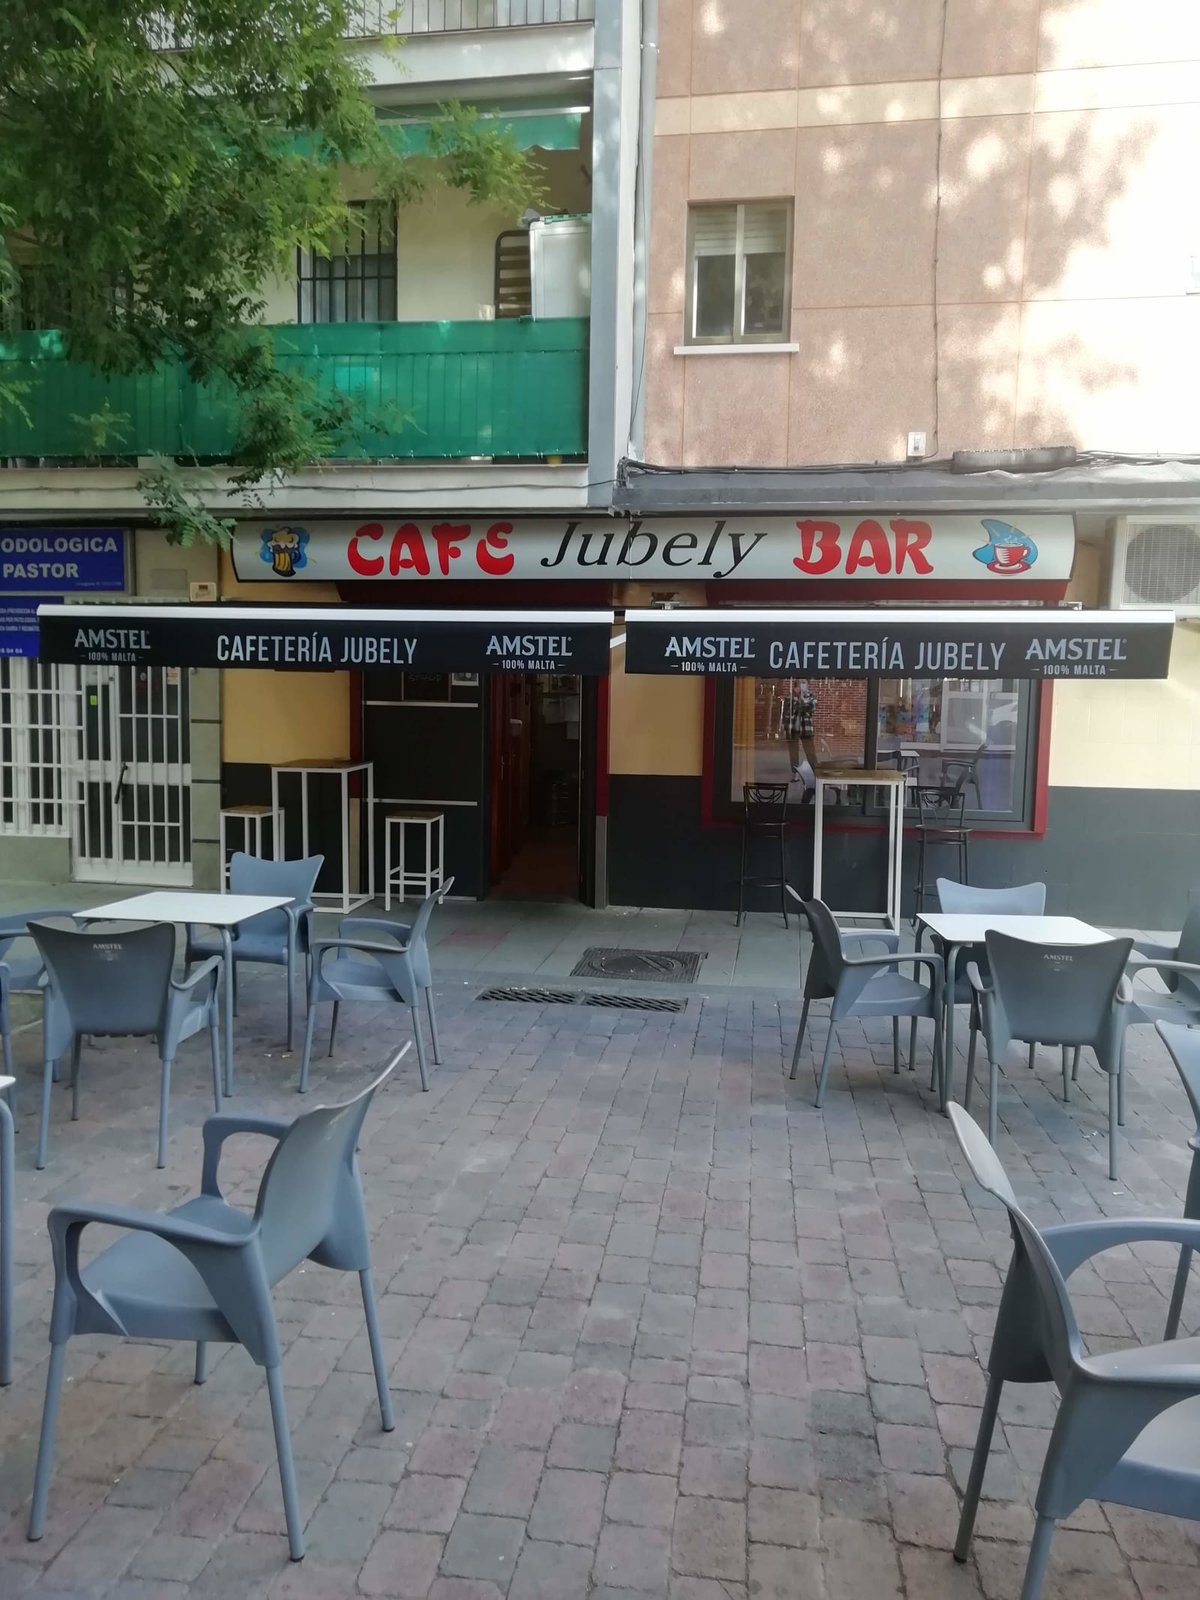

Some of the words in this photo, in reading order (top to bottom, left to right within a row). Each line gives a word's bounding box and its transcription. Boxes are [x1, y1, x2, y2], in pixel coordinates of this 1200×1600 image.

[1, 537, 118, 553] ODOLOGICA
[347, 521, 515, 576] CAFE
[541, 517, 768, 580] Jubely
[792, 519, 934, 576] BAR
[2, 563, 79, 579] PASTOR
[74, 629, 152, 650] AMSTEL
[217, 632, 332, 663] CAFETERÍA
[340, 637, 418, 665] JUBELY
[485, 635, 573, 657] AMSTEL
[664, 637, 756, 659] AMSTEL
[88, 651, 109, 662] 100%
[111, 652, 137, 662] MALTA
[769, 637, 905, 671] CAFETERÍA
[914, 642, 1007, 672] JUBELY
[1024, 638, 1127, 661] AMSTEL
[502, 659, 525, 670] 100%
[527, 660, 556, 671] MALTA
[681, 661, 705, 672] 100%
[708, 662, 738, 673] MALTA
[1043, 664, 1070, 675] 100%
[1073, 664, 1106, 675] MALTA
[1043, 953, 1074, 962] AMSTEL
